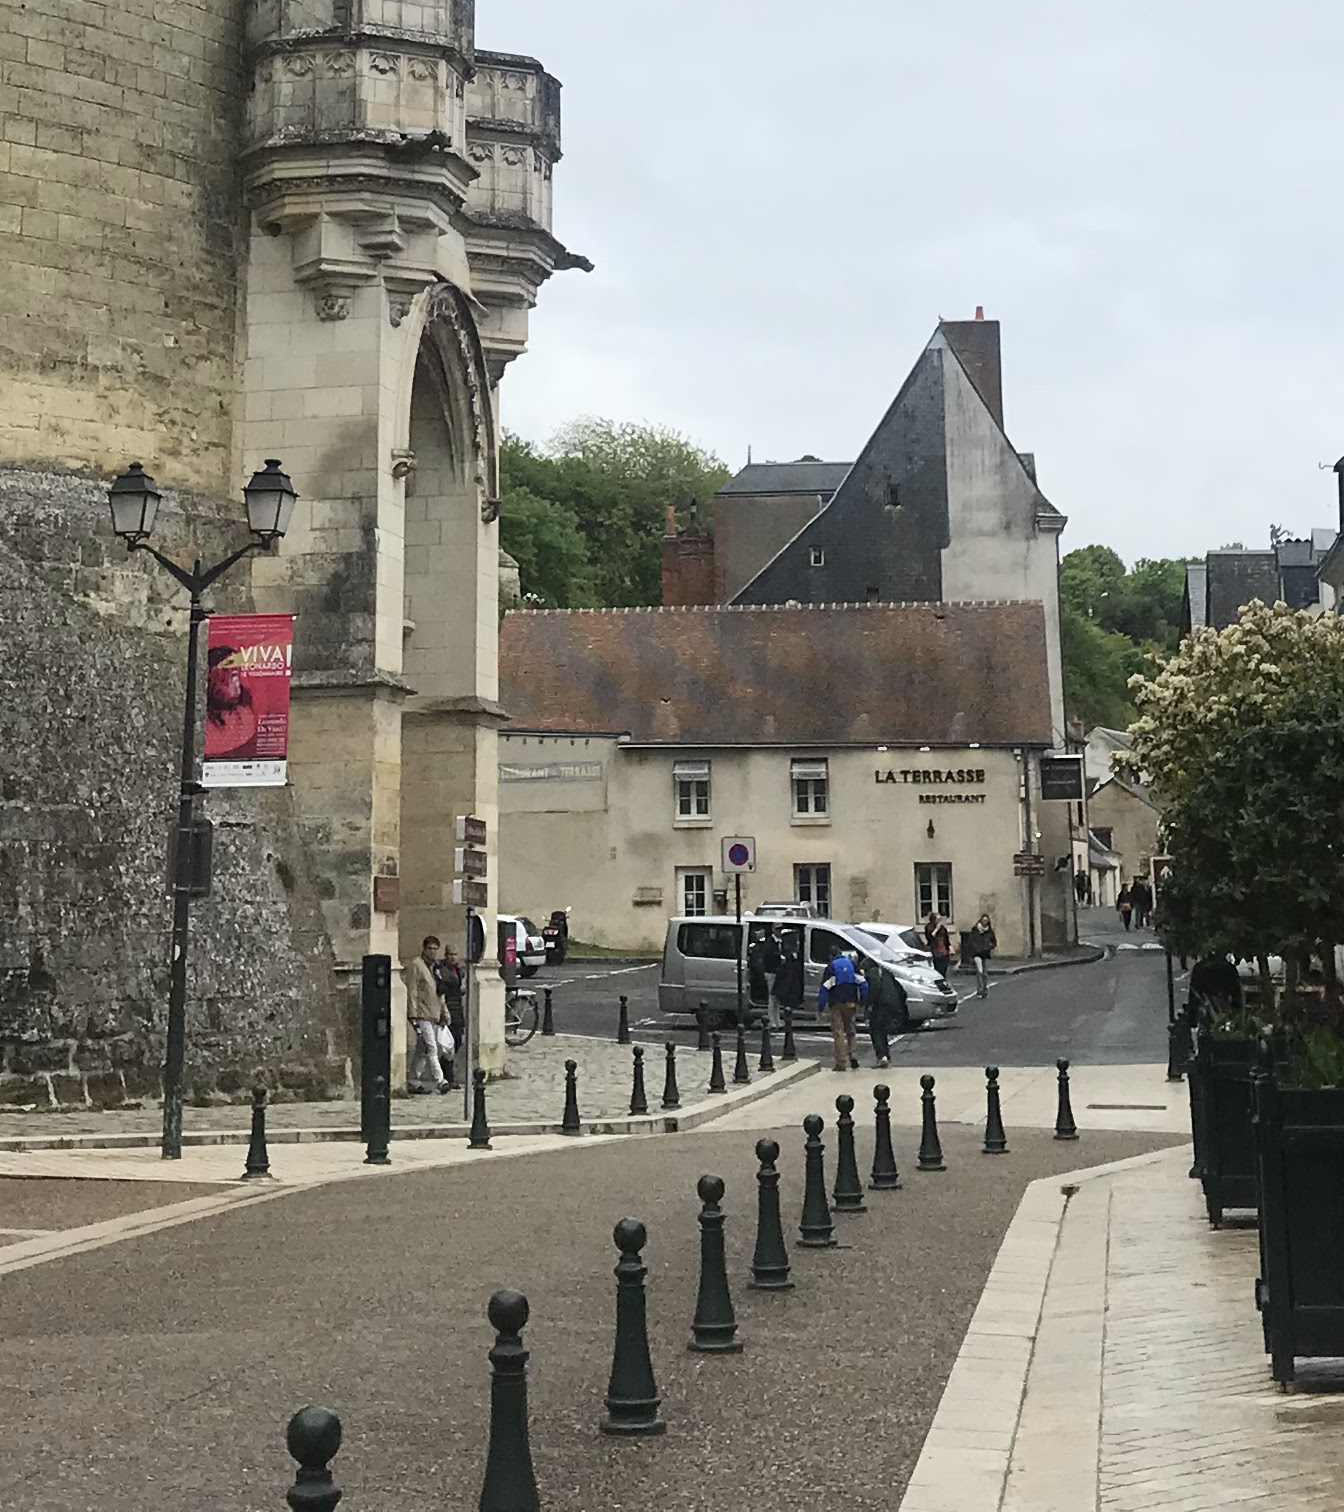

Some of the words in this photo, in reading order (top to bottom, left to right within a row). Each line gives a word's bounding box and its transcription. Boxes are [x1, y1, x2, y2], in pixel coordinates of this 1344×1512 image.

[874, 769, 897, 784] LA
[899, 768, 986, 784] TERRASSE
[918, 794, 987, 805] RESTAURANT
